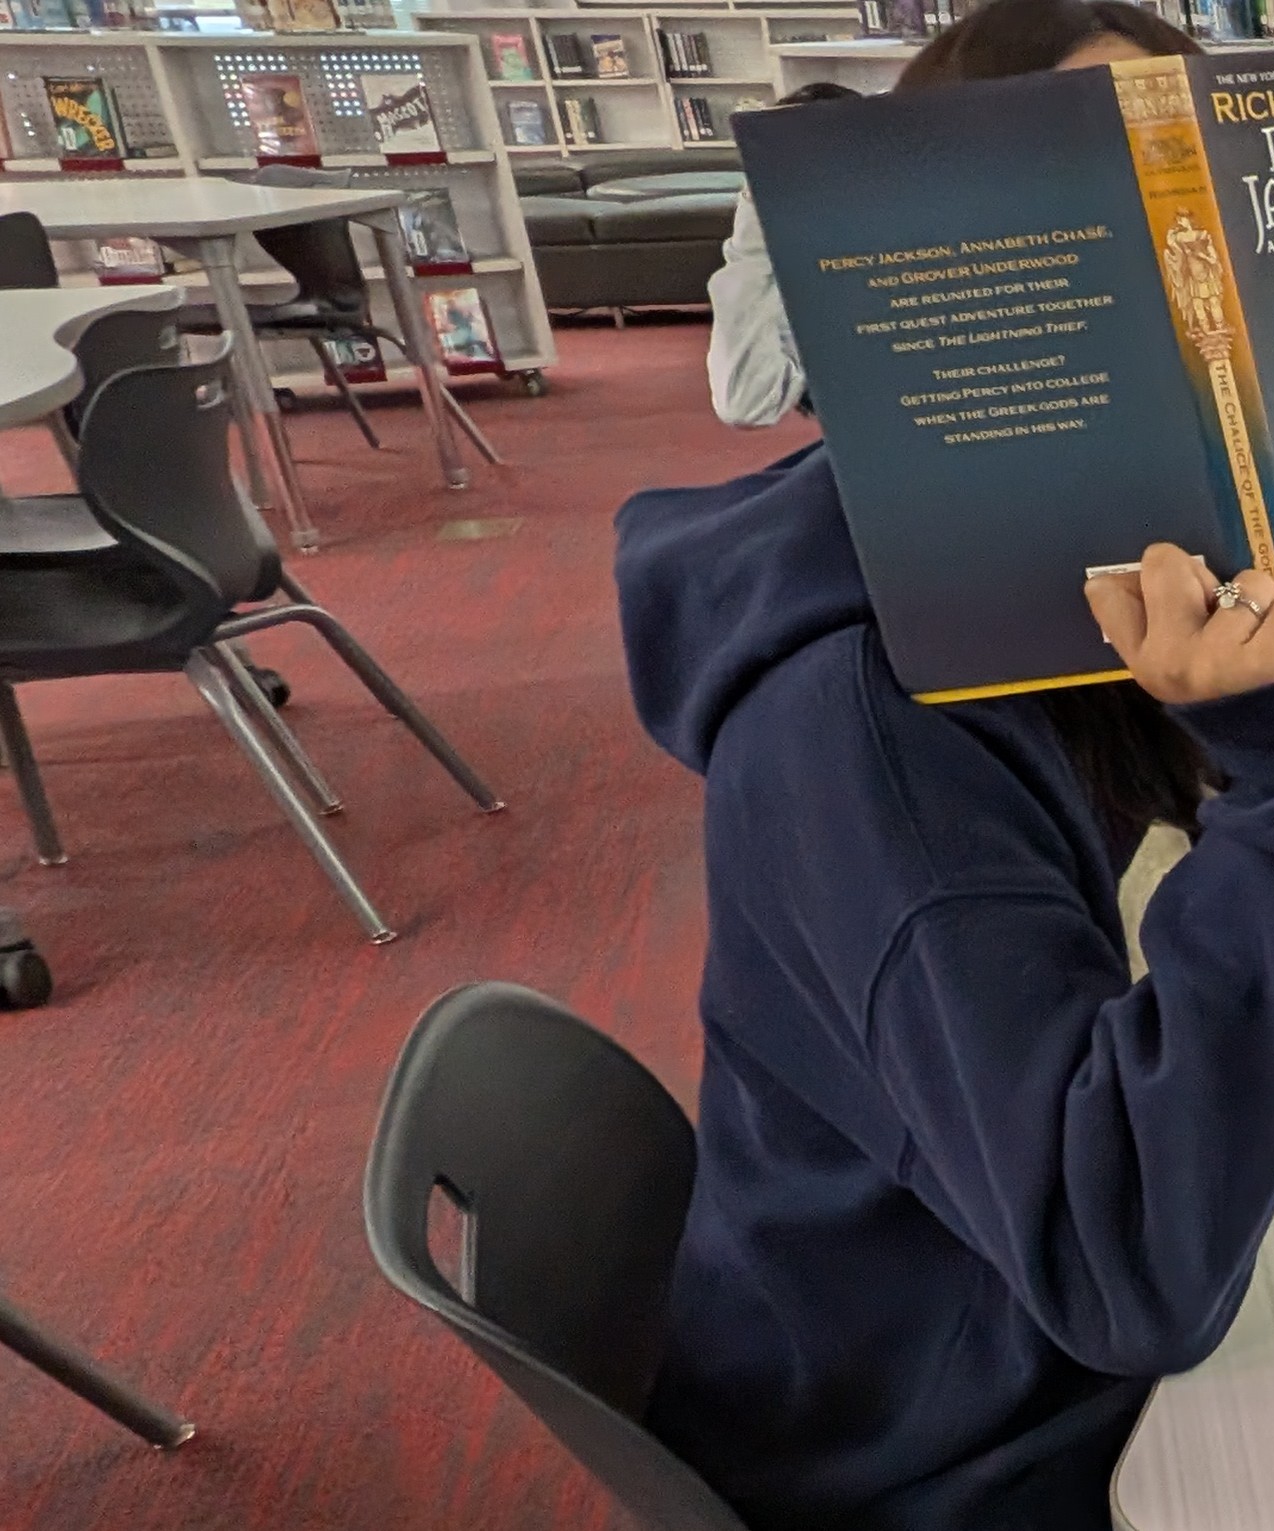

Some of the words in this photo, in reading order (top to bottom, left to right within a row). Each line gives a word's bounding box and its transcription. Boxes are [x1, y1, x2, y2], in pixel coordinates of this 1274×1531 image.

[51, 96, 115, 151] WRECKER
[376, 97, 426, 126] MASCOT
[819, 254, 875, 272] PERCY
[879, 246, 957, 265] JACKSON,
[960, 233, 1049, 254] ANNABETH
[868, 276, 899, 288] AND
[901, 266, 970, 285] GROVER
[972, 252, 1080, 275] UNDERWOOD
[891, 297, 918, 308] ARE
[921, 287, 994, 305] REUNITED
[994, 282, 1025, 296] FOR
[1027, 277, 1071, 292] THEIR
[856, 320, 897, 335] FIRST
[899, 315, 947, 330] QUEST
[951, 304, 1035, 323] ADVENTURE
[1036, 294, 1114, 312] TOGETHER
[891, 338, 935, 353] SINCE
[939, 334, 967, 348] THE
[968, 326, 1043, 345] LIGHTNING
[932, 366, 976, 380] THEIR
[977, 355, 1066, 376] CHALLENGE?
[901, 389, 961, 407] GETTING
[962, 384, 1009, 399] PERCY
[1011, 379, 1044, 393] INTO
[1045, 371, 1111, 389] COLLEGE
[914, 413, 957, 427] WHEN
[958, 408, 987, 421] THE
[988, 403, 1037, 418] GREEK
[1038, 397, 1079, 411] GODS
[1081, 393, 1111, 406] ARE
[944, 426, 1013, 444] STANDING
[1015, 425, 1030, 436] IN
[1031, 423, 1056, 434] HIS
[1215, 363, 1230, 397] THE
[1225, 402, 1249, 476] CHALICE
[1241, 479, 1255, 501] OF
[1249, 507, 1264, 539] THE
